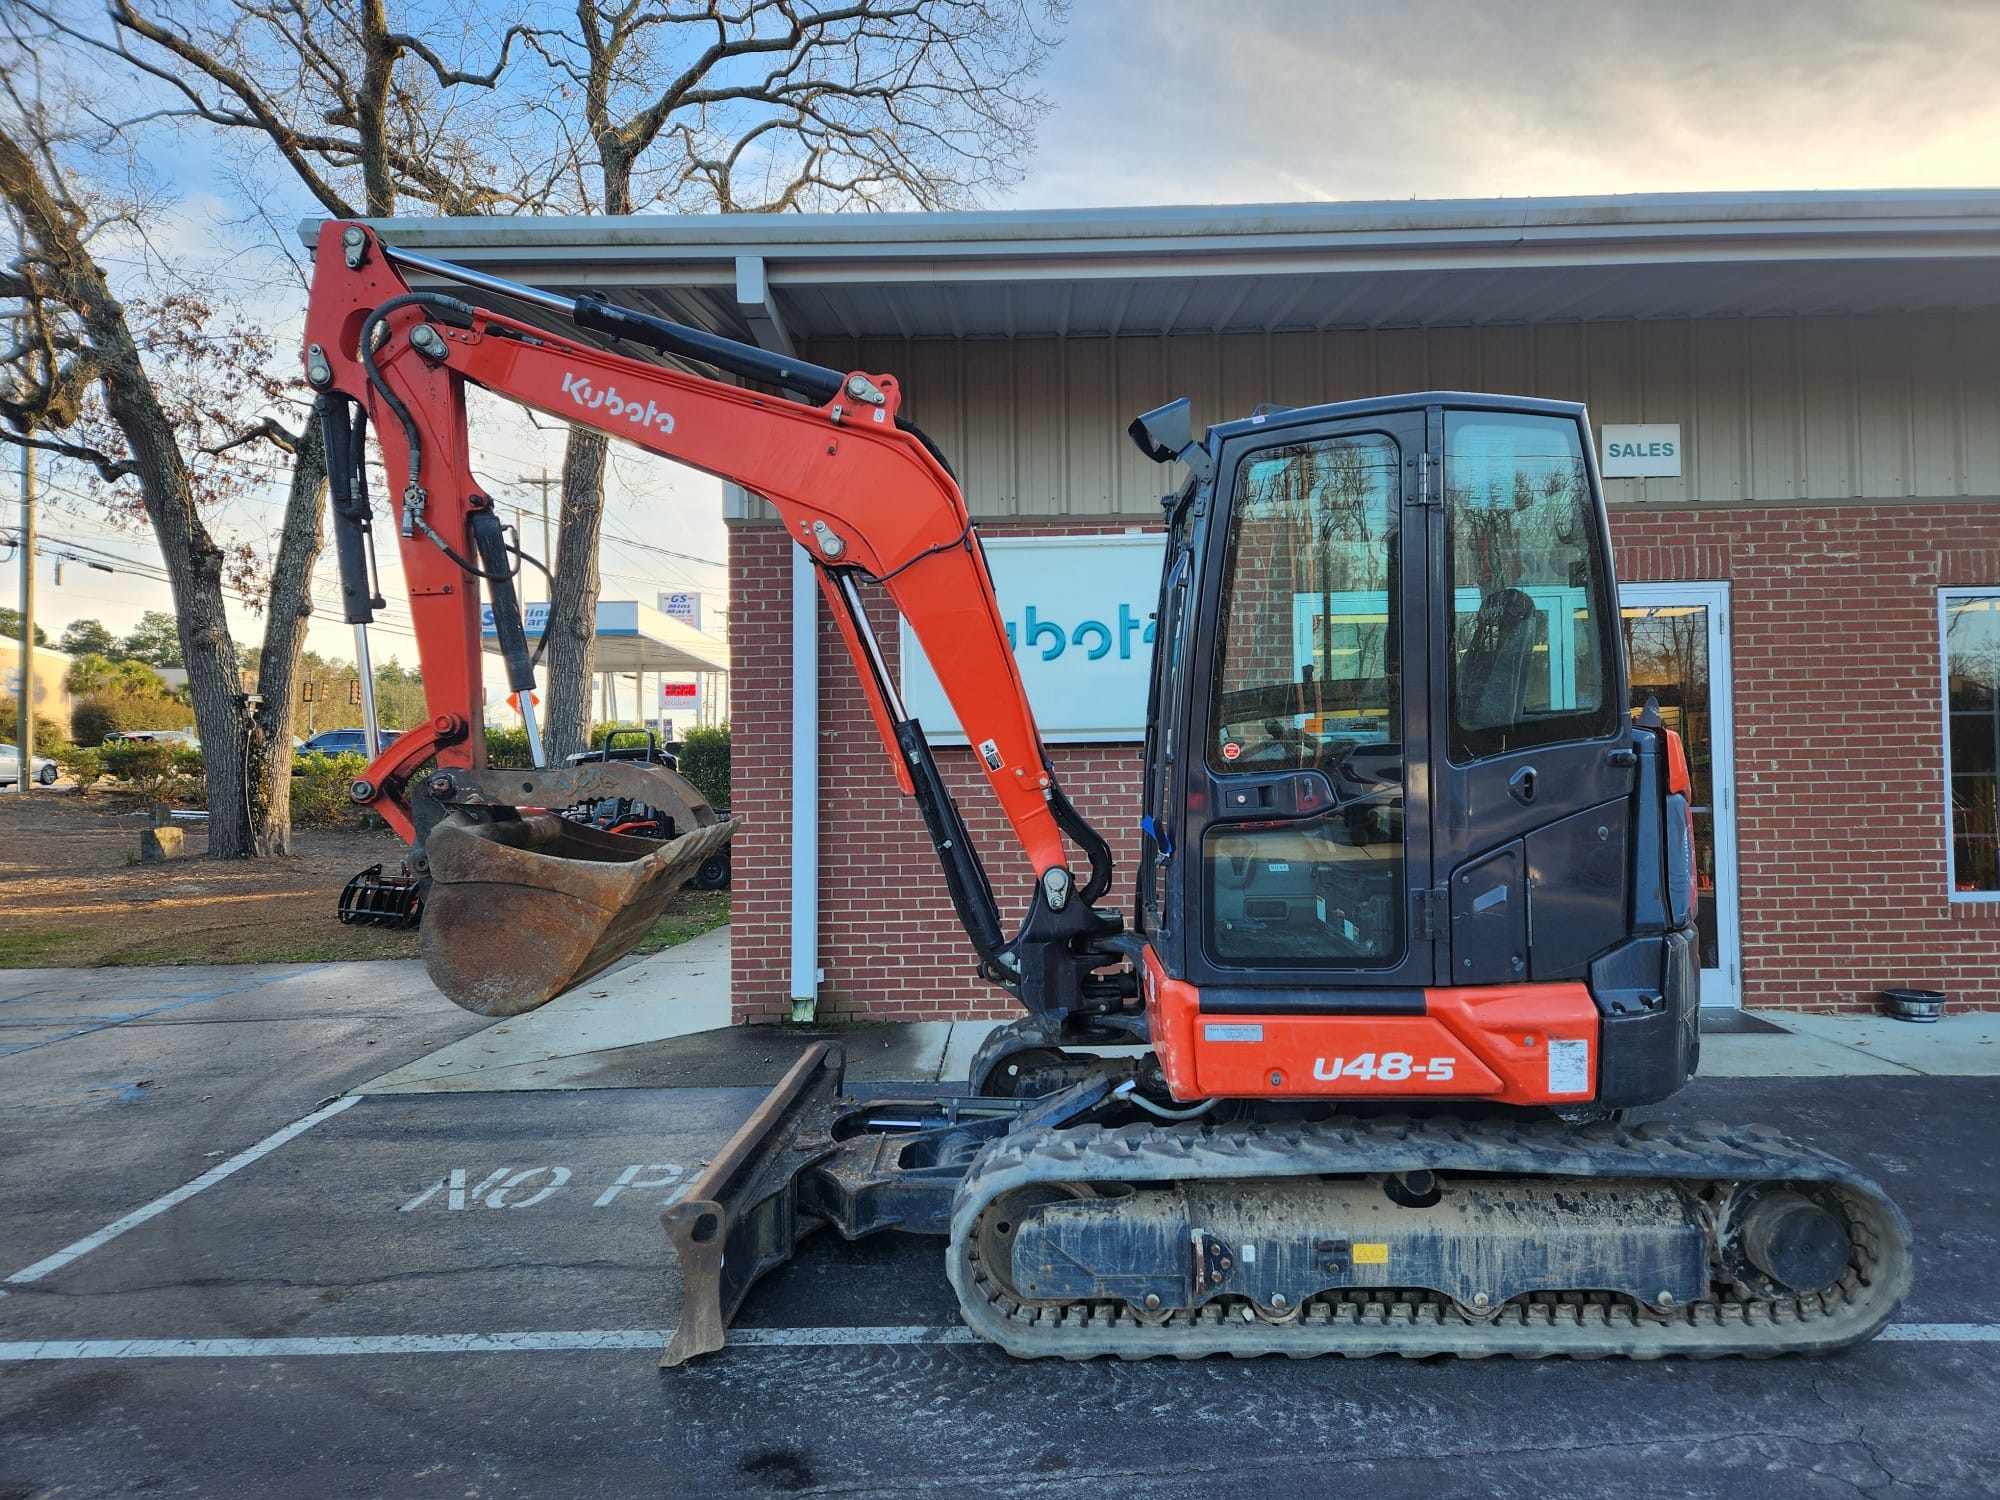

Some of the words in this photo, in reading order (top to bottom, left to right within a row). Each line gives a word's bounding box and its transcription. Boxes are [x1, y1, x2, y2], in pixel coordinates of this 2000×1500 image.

[561, 371, 675, 434] Kubota
[1608, 442, 1675, 458] SALES
[670, 594, 688, 603] GS
[1312, 1051, 1456, 1081] U48-5
[397, 1165, 573, 1212] NO
